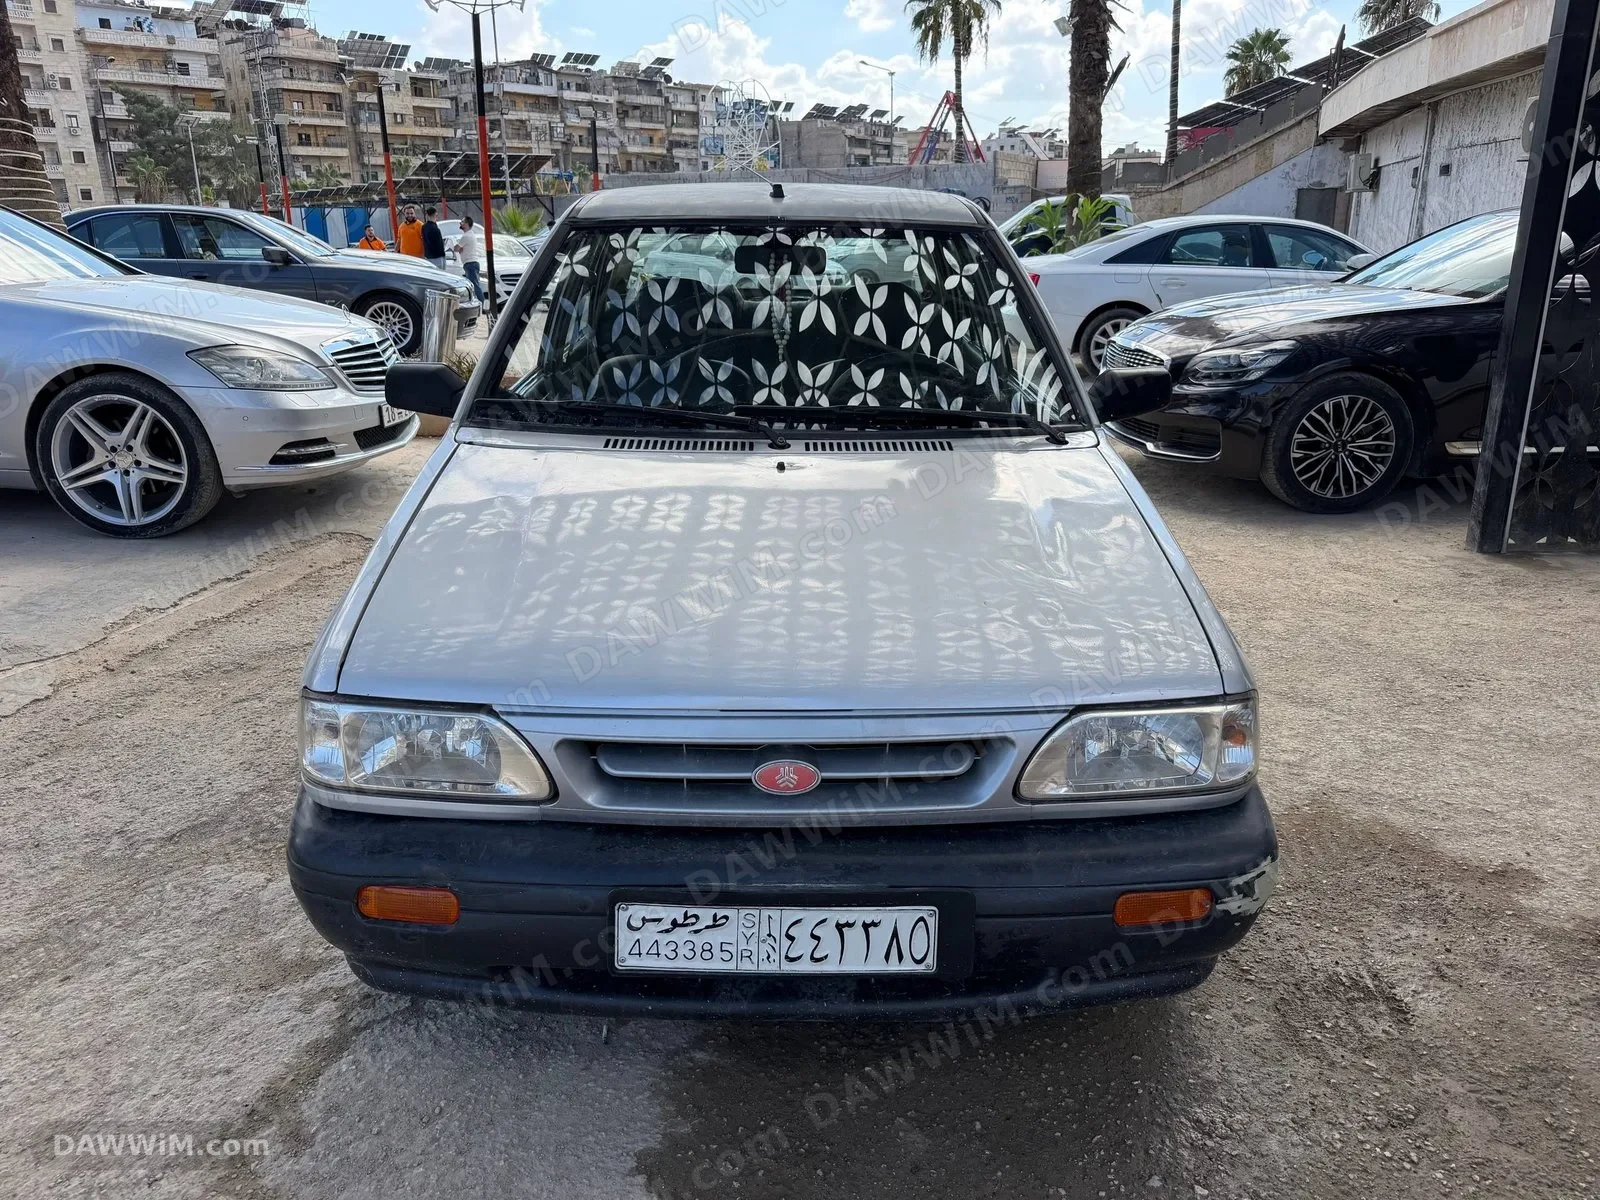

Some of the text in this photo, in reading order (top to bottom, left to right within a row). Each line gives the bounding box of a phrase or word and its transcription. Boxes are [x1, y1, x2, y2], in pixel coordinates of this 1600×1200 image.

[627, 910, 730, 934] طرطوس
[741, 913, 756, 965] SYR
[784, 915, 931, 966] ٤٤٣٣٨٥
[628, 937, 734, 963] 443385
